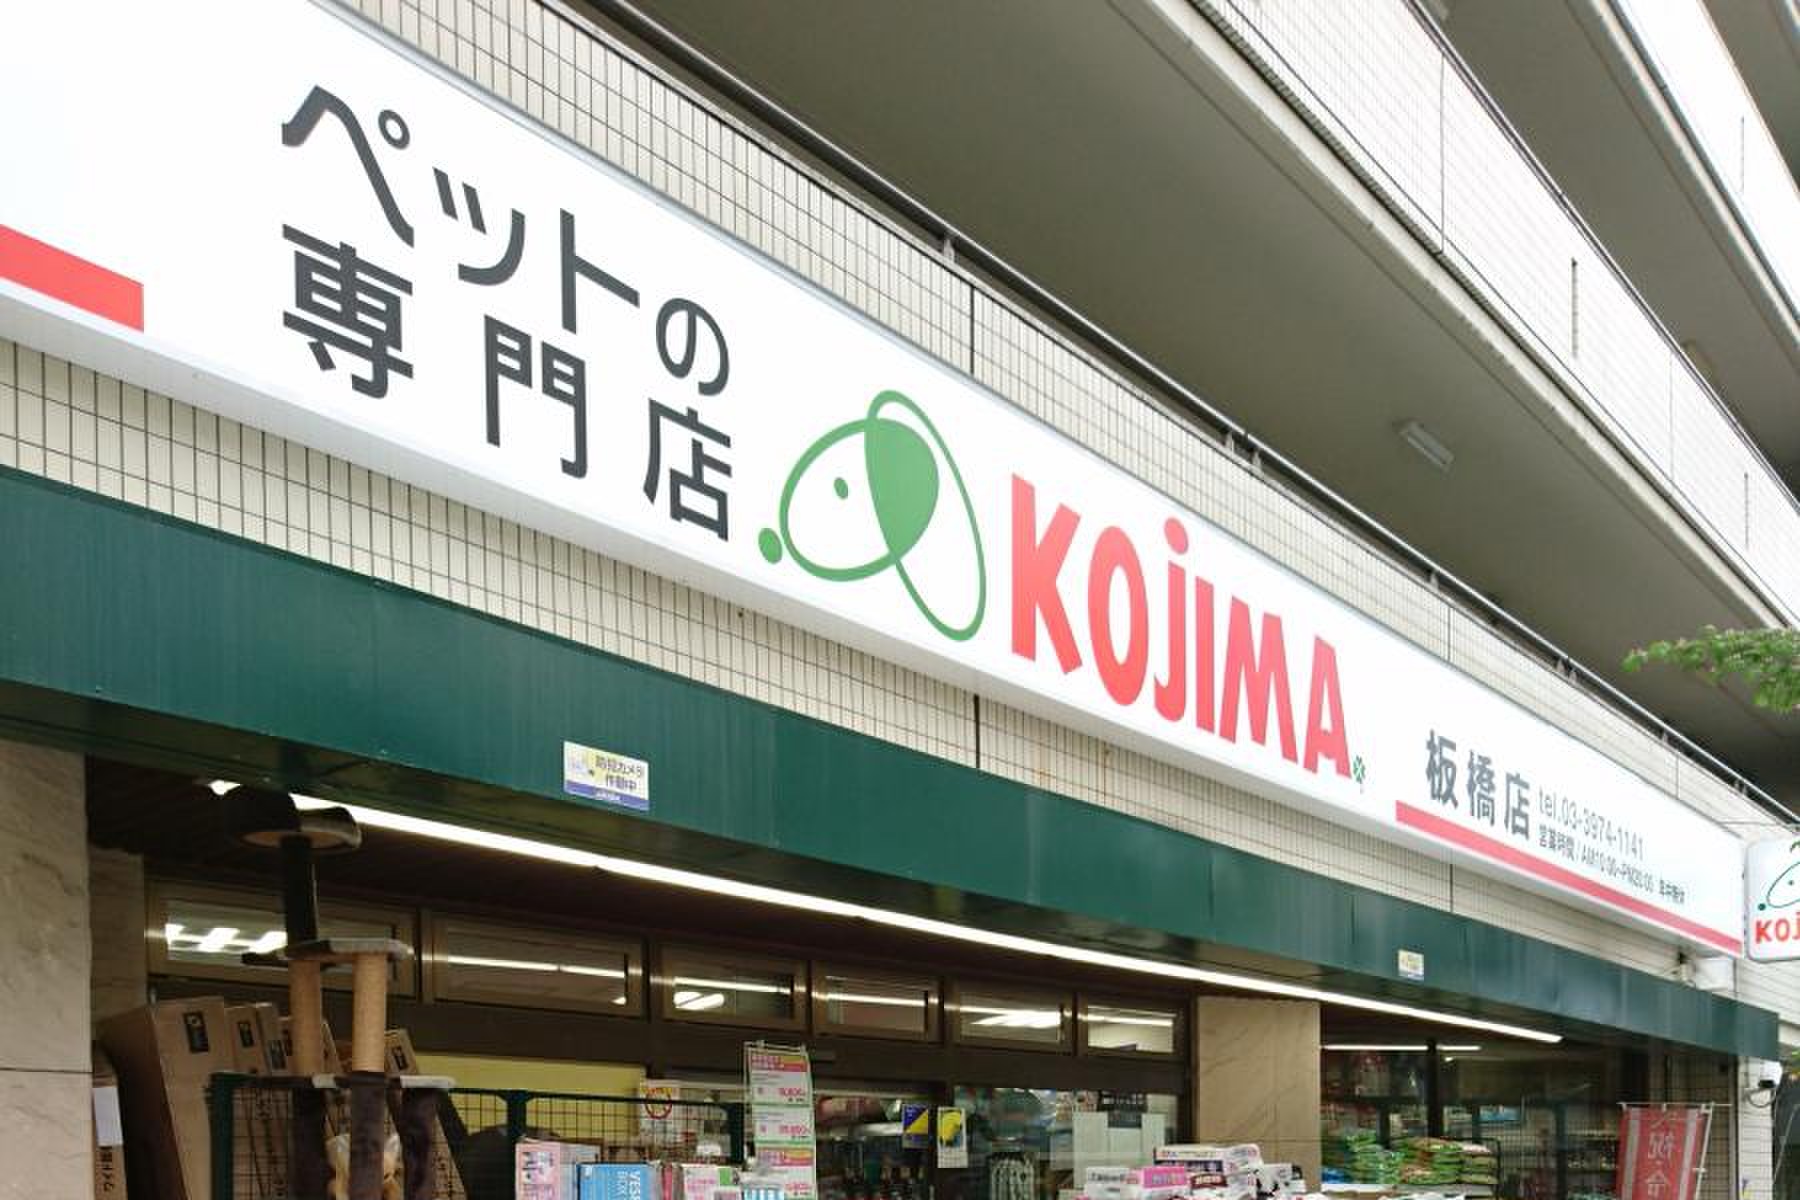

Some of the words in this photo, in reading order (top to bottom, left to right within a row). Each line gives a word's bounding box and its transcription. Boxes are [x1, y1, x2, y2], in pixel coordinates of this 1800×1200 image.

[281, 84, 731, 397] ペットの
[281, 223, 733, 543] 専門店
[1425, 728, 1531, 840] 板橋店
